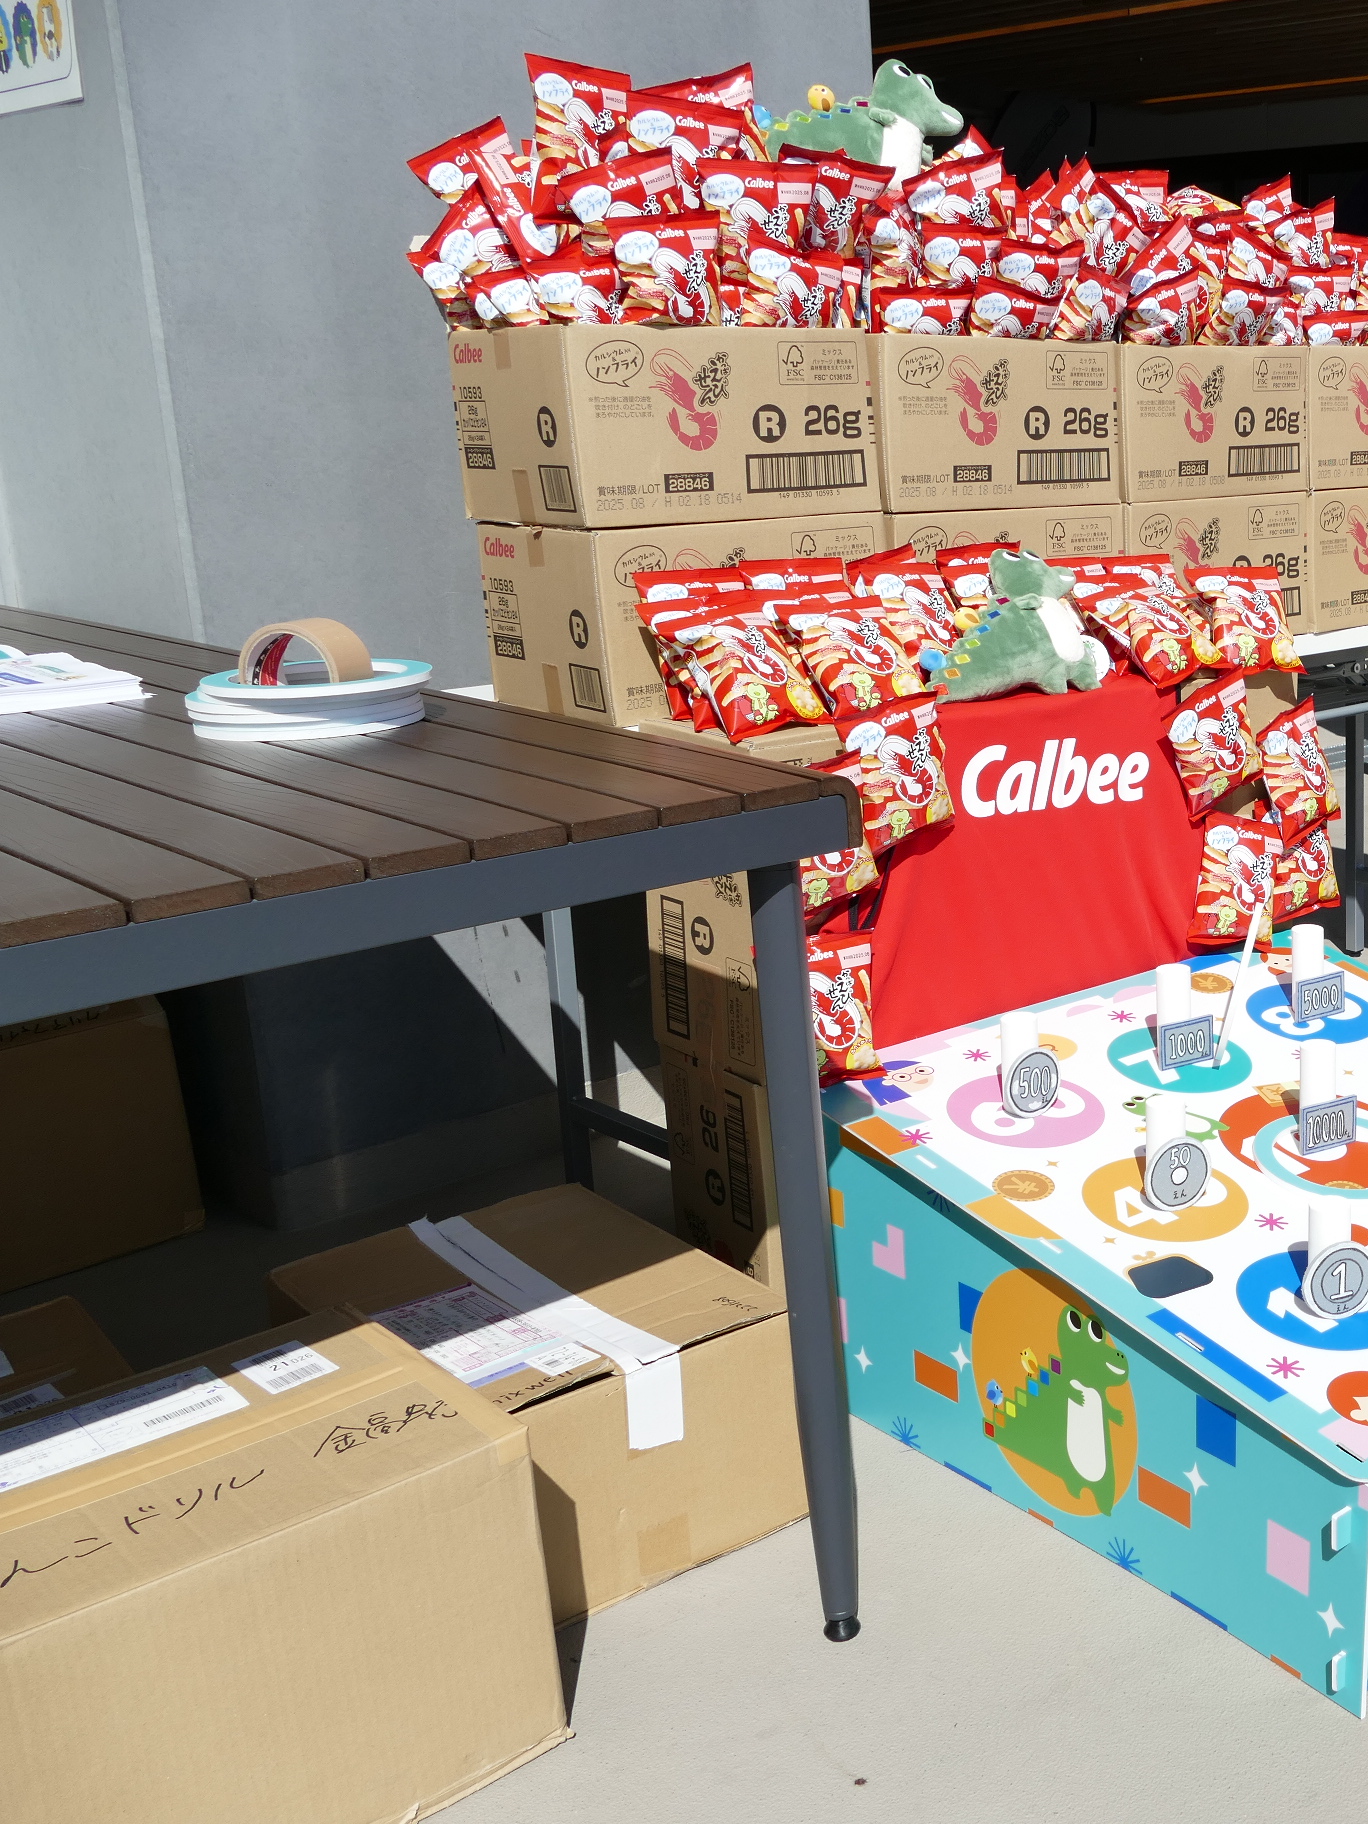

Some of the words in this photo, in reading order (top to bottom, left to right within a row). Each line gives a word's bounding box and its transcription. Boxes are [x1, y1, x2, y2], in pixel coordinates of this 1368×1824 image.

[572, 79, 599, 93] Calbee
[675, 115, 705, 129] Calbee
[821, 166, 850, 181] Calbee
[943, 172, 968, 188] Calbee
[607, 176, 637, 192] Calbee
[745, 178, 774, 189] Calbee
[655, 228, 685, 239] Calbee
[958, 238, 981, 248] Calbee
[1035, 255, 1055, 265] Calbee
[1148, 249, 1167, 269] Calbee
[922, 298, 946, 308] Calbee
[1012, 299, 1034, 309] Calbee
[454, 343, 482, 364] Calbee
[596, 356, 638, 378] ノンフライ
[905, 363, 939, 380] ノンフライ
[459, 387, 482, 399] 10593
[804, 404, 862, 439] 26g
[1063, 407, 1109, 438] 26g
[1265, 406, 1300, 434] 26g
[468, 453, 492, 467] 28846
[956, 470, 988, 481] 28846
[1181, 464, 1205, 474] 28846
[669, 478, 710, 491] 28846
[901, 474, 950, 485] 賞味期限/LOT
[597, 484, 661, 497] 賞味期限/LOT
[1080, 522, 1099, 530] ミックス
[834, 534, 858, 542] ミックス
[484, 537, 515, 558] Calbee
[490, 578, 513, 592] 10593
[784, 574, 809, 583] Calbee
[498, 641, 522, 657] 28846
[1195, 695, 1216, 713] Calbee
[881, 710, 909, 728] Calbee
[961, 737, 1150, 818] Calbee
[1239, 829, 1262, 841] Calbee
[1304, 984, 1338, 1016] 5000
[1169, 1029, 1205, 1060] 1000
[1019, 1066, 1051, 1098] 500
[1307, 1110, 1344, 1148] 10000
[1170, 1146, 1191, 1169] 50
[1173, 1190, 1187, 1199] えん
[1329, 1262, 1354, 1301] 1
